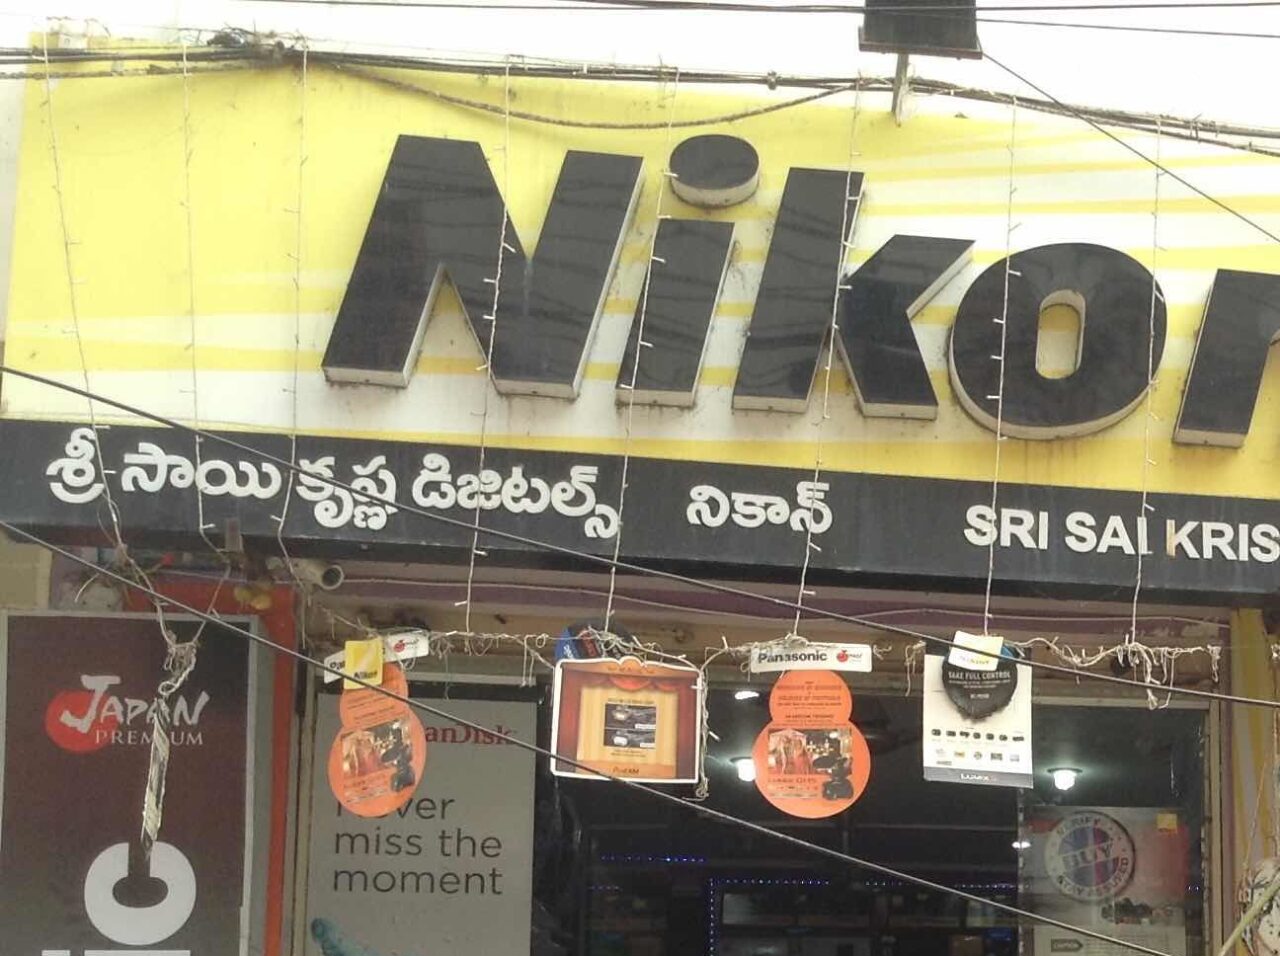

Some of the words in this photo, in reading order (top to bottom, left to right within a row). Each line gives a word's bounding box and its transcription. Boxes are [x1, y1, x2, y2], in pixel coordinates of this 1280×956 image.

[45, 426, 103, 504] శ్రీ
[121, 441, 283, 501] సాయి
[295, 454, 399, 532] కృష్ణ
[686, 480, 834, 535] నికాన్
[963, 504, 1050, 551] SRI
[1064, 515, 1153, 555] SAI
[757, 649, 828, 665] Panasonic
[95, 729, 204, 746] PREMUM
[424, 722, 515, 745] anDisk
[333, 829, 423, 859] miss
[438, 827, 503, 859] the
[332, 864, 504, 895] moment
